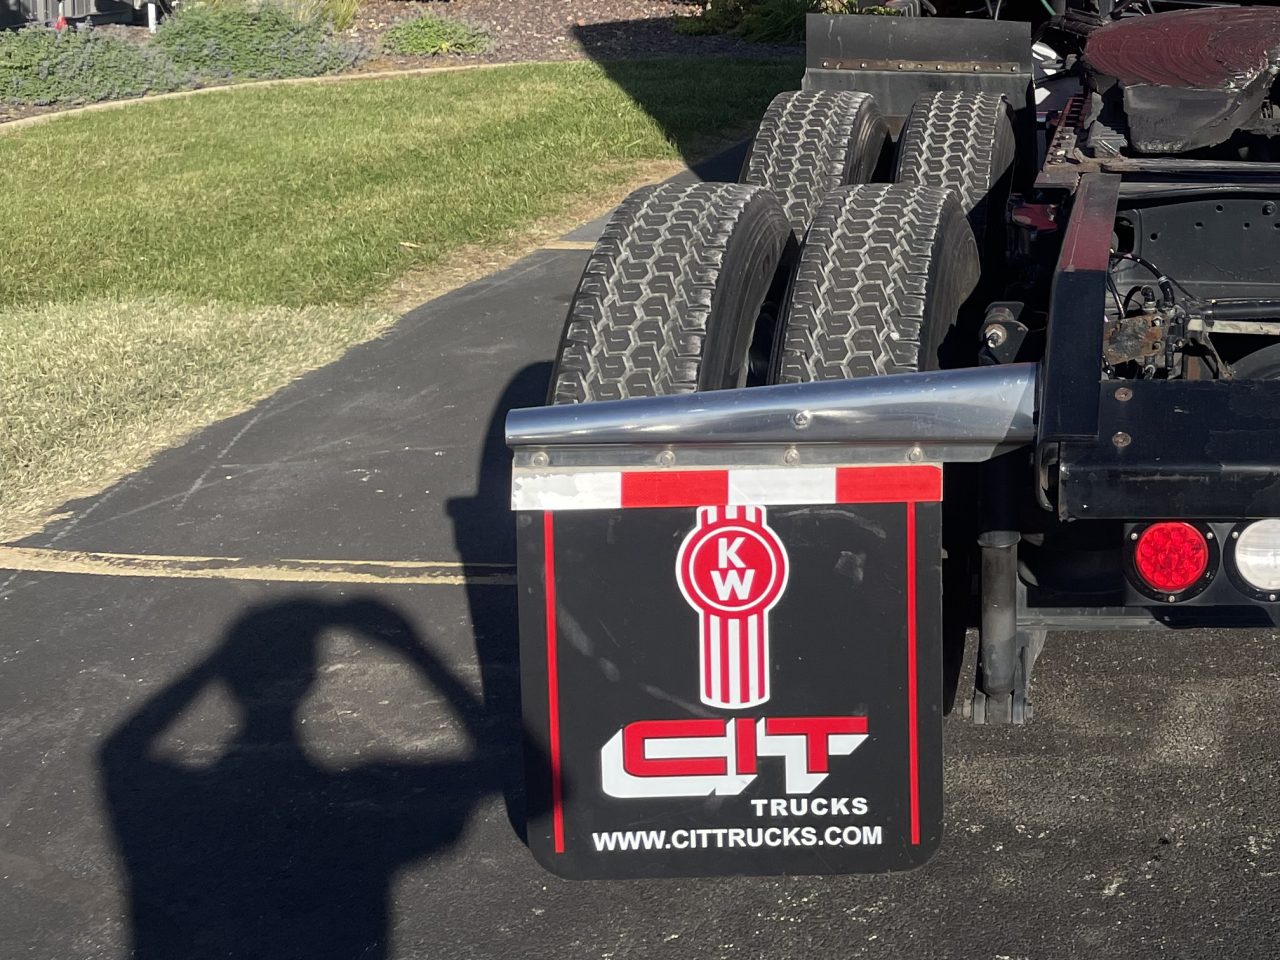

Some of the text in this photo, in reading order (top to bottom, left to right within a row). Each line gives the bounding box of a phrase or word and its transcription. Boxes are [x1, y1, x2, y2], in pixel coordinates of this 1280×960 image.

[717, 537, 746, 569] K
[710, 569, 755, 601] W
[601, 716, 869, 798] CIT
[751, 797, 869, 816] TRUCKS
[592, 825, 882, 852] WWW.CITTRUCKS.COM
